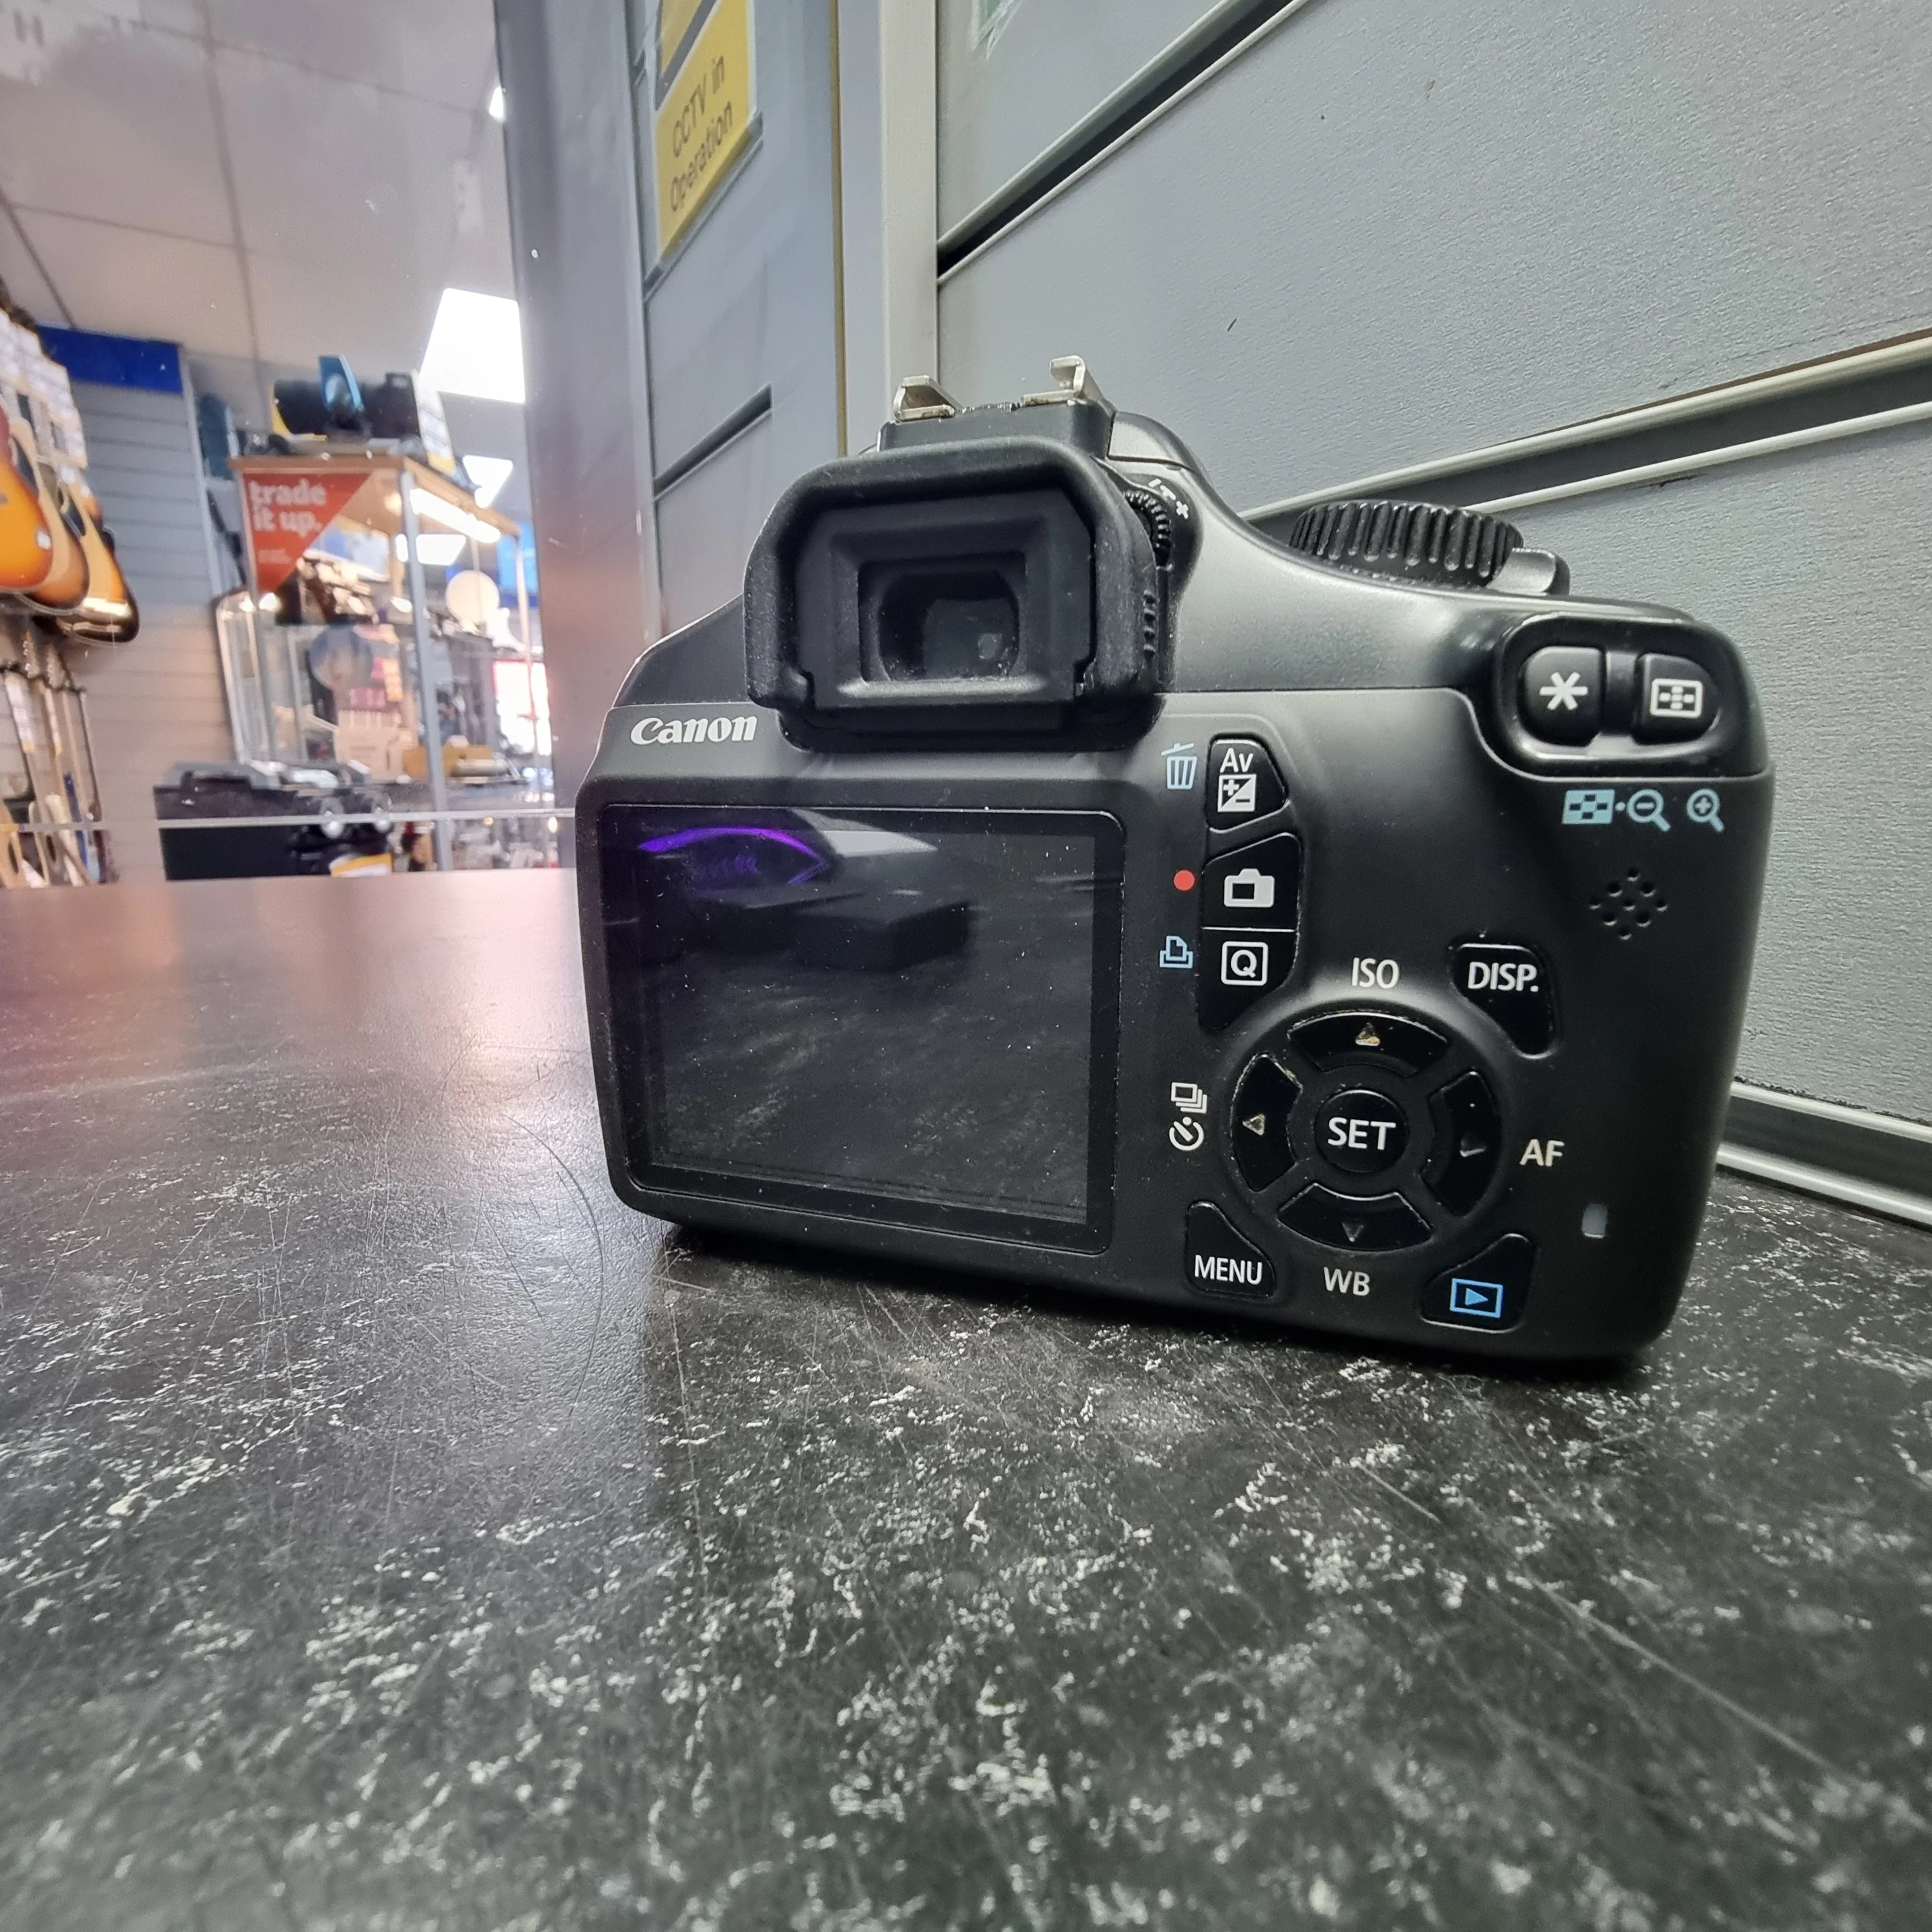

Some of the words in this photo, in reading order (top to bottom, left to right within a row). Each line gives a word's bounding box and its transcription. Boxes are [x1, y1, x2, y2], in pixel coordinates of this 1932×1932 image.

[673, 74, 707, 158] CCTV
[712, 56, 724, 94] in
[670, 101, 734, 212] Operation
[249, 478, 327, 506] trade
[252, 504, 276, 531] it
[630, 716, 757, 745] Canon
[1220, 748, 1254, 774] Av
[1230, 949, 1257, 978] Q
[1351, 958, 1400, 989] ISO
[1468, 961, 1539, 992] DISP.
[1327, 1116, 1397, 1151] SET
[1519, 1138, 1565, 1167] AF
[1193, 1254, 1263, 1286] MENU
[1323, 1266, 1371, 1297] WB
